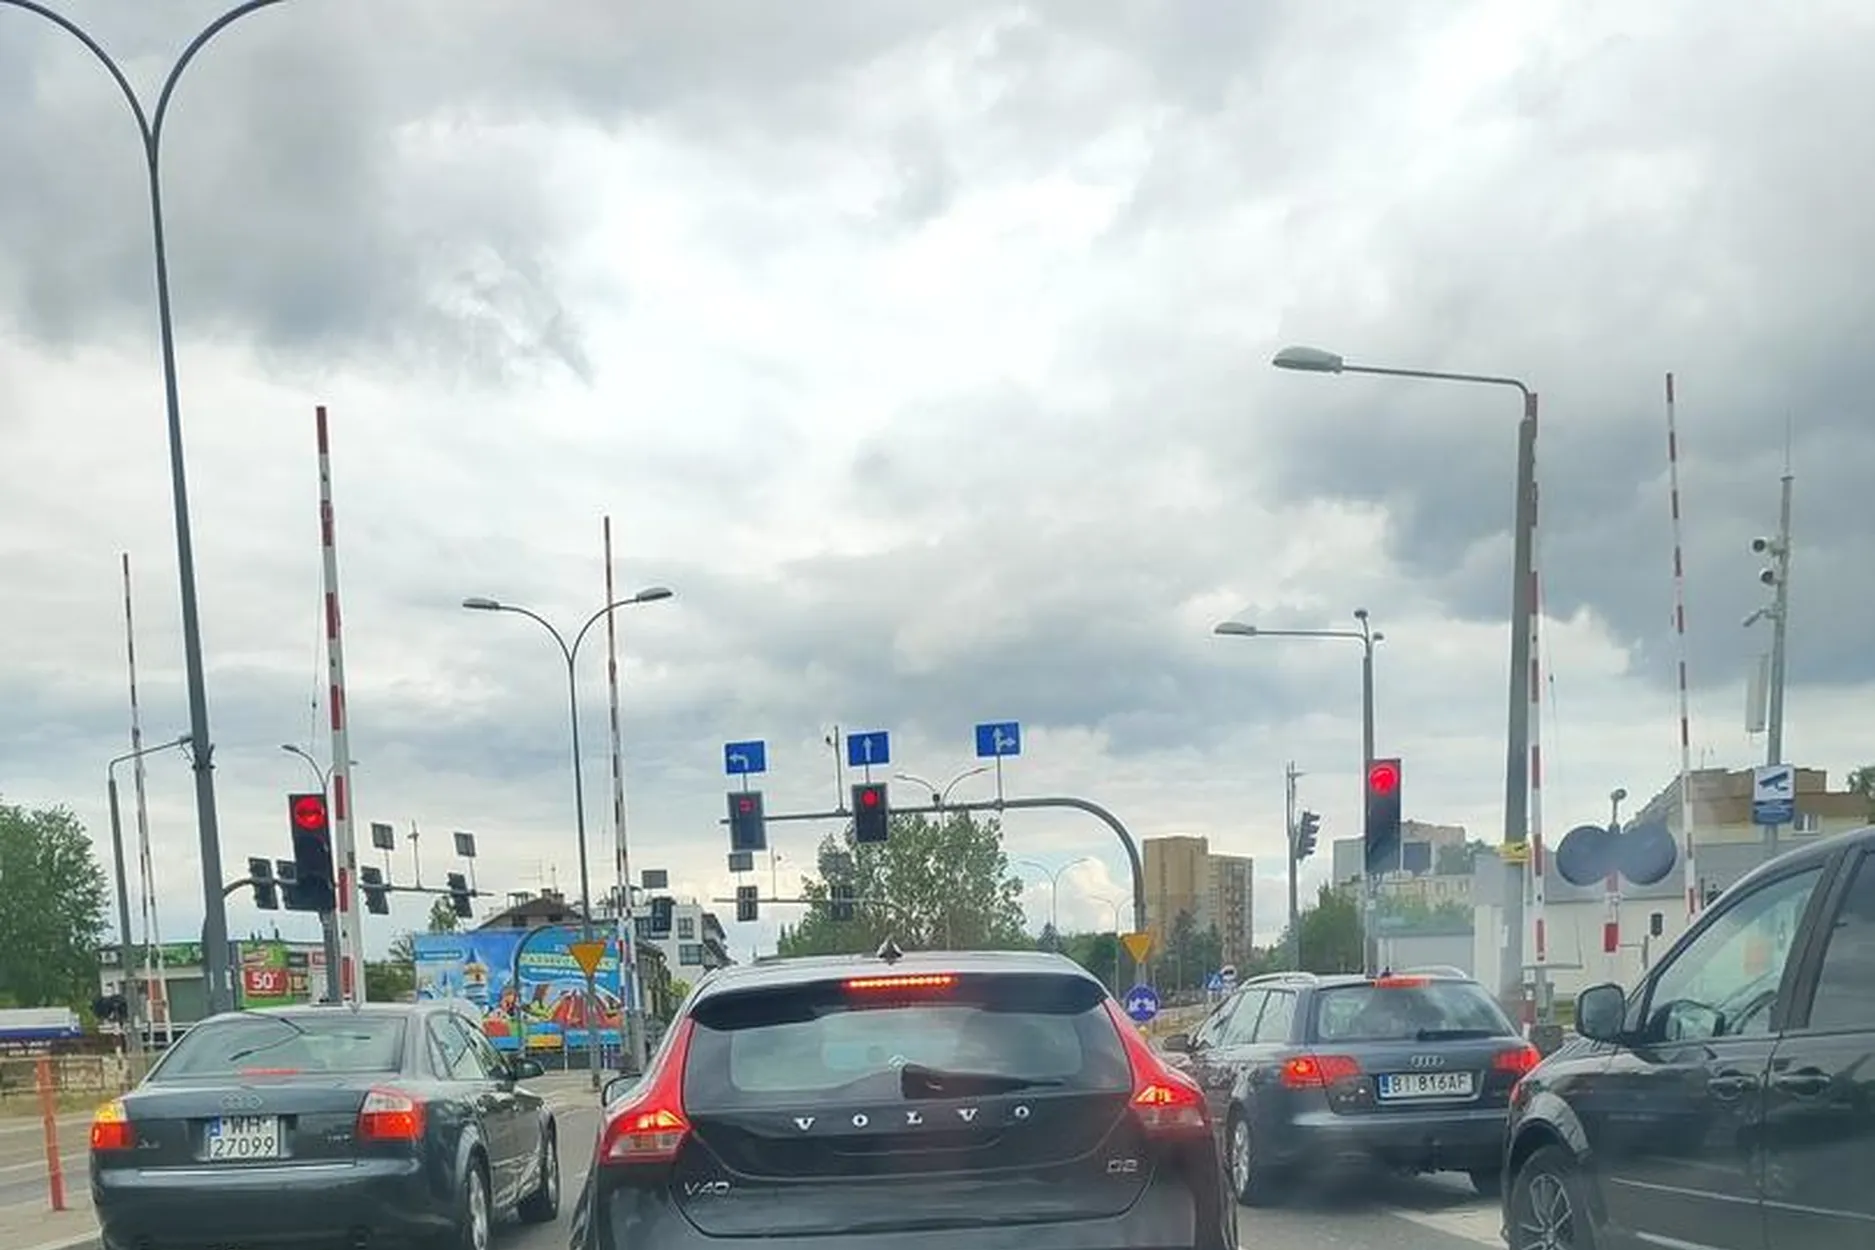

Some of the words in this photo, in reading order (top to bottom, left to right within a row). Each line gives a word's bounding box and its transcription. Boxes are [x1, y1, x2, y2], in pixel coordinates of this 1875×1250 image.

[794, 1105, 1030, 1131] VOLVO
[214, 1136, 275, 1157] 27099
[684, 1181, 730, 1196] V40
